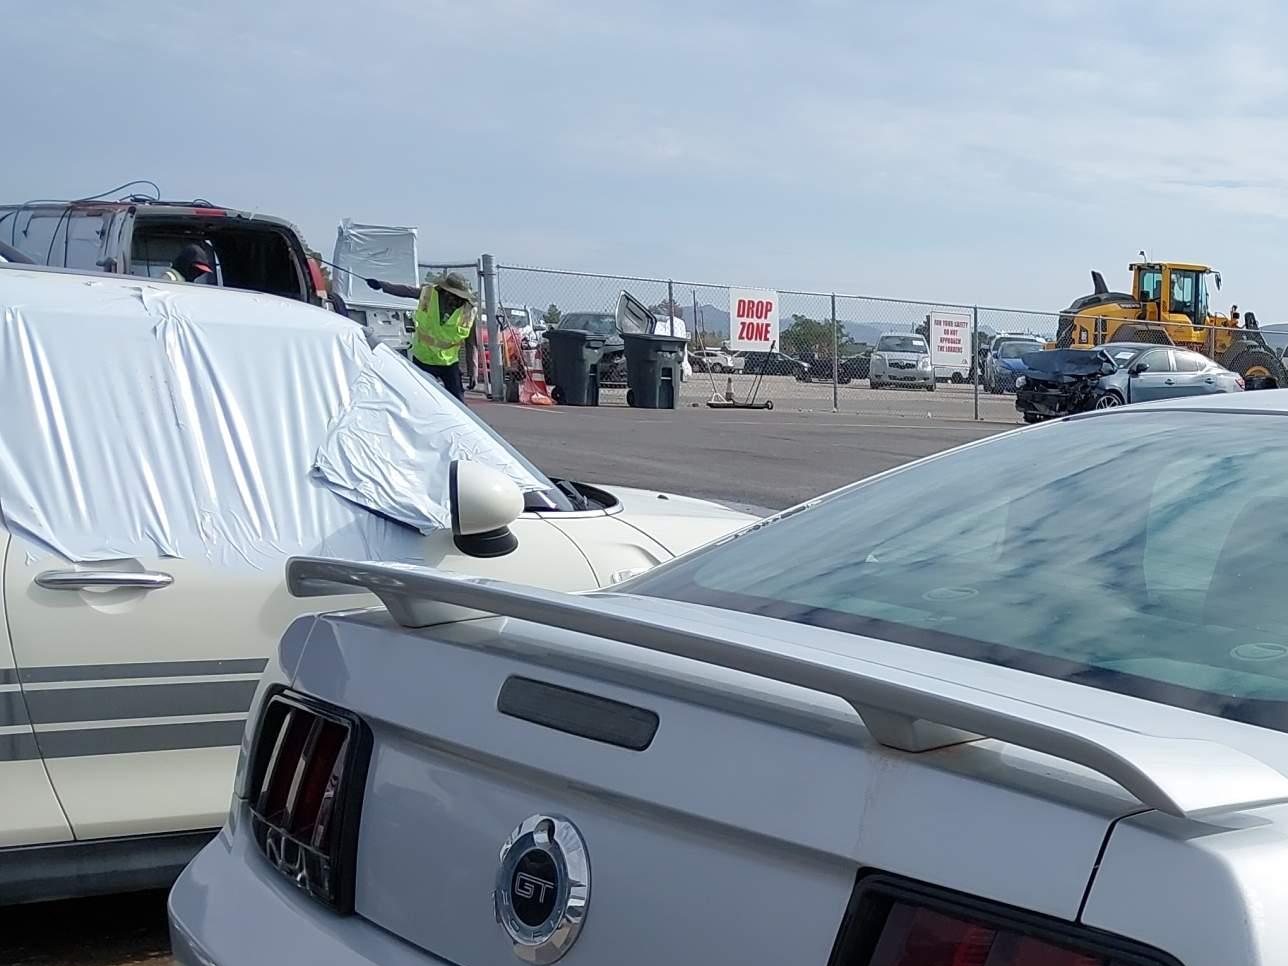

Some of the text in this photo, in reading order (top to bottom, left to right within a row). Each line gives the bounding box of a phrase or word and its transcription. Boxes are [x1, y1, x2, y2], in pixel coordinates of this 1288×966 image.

[737, 299, 773, 320] DROP
[738, 321, 771, 341] ZONE
[940, 336, 961, 344] APPROACH
[514, 871, 554, 904] GT
